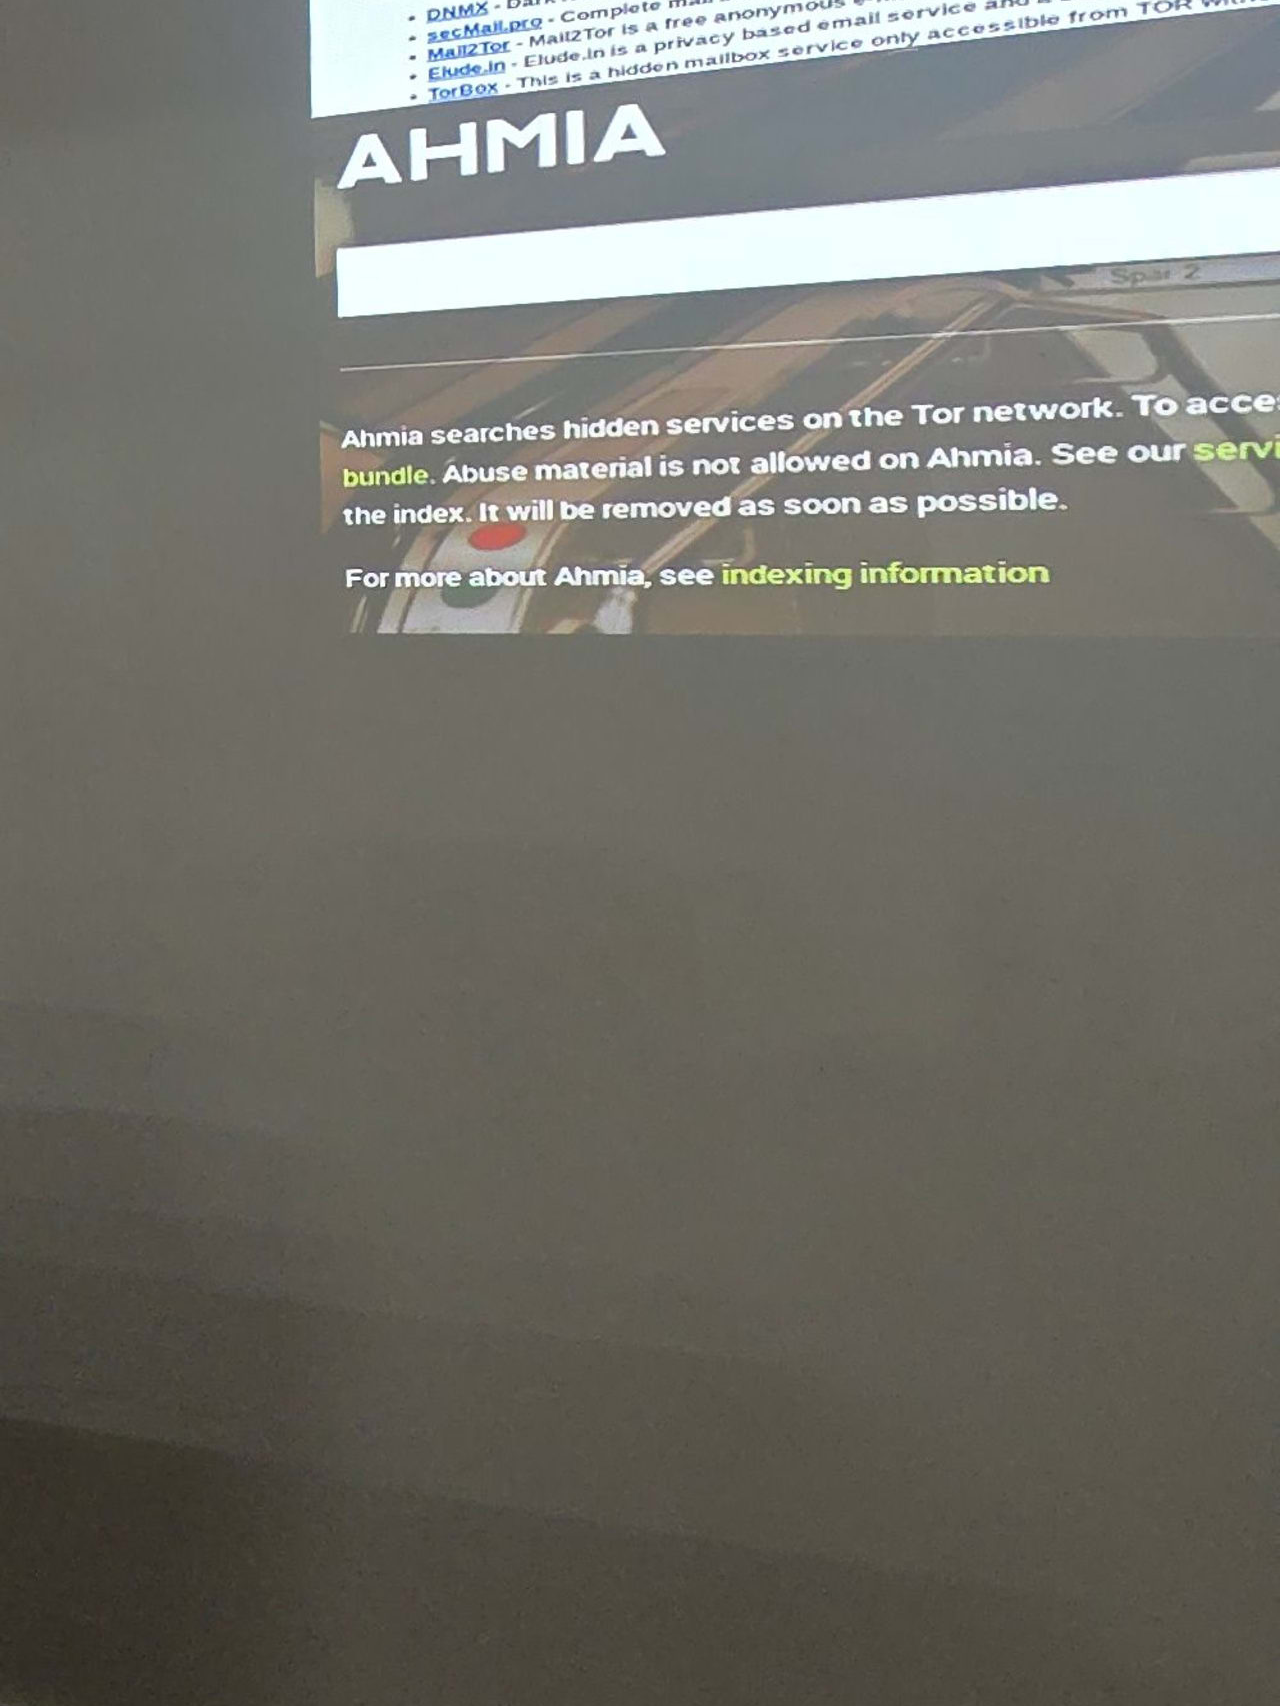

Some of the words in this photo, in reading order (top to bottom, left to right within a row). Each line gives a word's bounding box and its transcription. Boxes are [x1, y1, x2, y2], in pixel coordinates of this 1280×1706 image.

[427, 1, 488, 23] DNMX
[427, 16, 543, 41] secMail.pro
[560, 1, 661, 23] Complete
[610, 44, 628, 57] is
[635, 43, 647, 54] a
[653, 30, 735, 55] privacy
[742, 19, 811, 41] based
[817, 11, 881, 31] email
[887, 0, 977, 24] service
[427, 40, 510, 61] Mail2Tor
[529, 26, 615, 48] Mail2Tor
[622, 23, 639, 35] is
[645, 21, 658, 32] a
[665, 12, 708, 30] free
[429, 79, 498, 101] TorBox
[517, 74, 559, 88] This
[566, 71, 582, 83] is
[589, 70, 601, 80] a
[608, 60, 679, 78] hidden
[684, 48, 770, 70] mailbox
[778, 36, 863, 58] service
[871, 29, 920, 48] only
[927, 14, 1061, 40] accessible
[1069, 6, 1128, 24] from
[337, 103, 666, 189] AHMIA
[342, 426, 423, 449] Ahmia
[431, 420, 556, 445] searches
[564, 414, 659, 439] hidden
[666, 410, 794, 435] services
[803, 410, 842, 430] on
[849, 406, 902, 429] the
[912, 403, 965, 425] Tor
[973, 396, 1124, 424] network.
[1132, 394, 1177, 417] To
[1186, 393, 1280, 416] acce
[343, 464, 435, 488] bundle.
[442, 462, 528, 484] Abuse
[535, 456, 651, 481] material
[659, 454, 685, 478] is
[692, 456, 741, 476] not
[751, 450, 870, 476] allowed
[879, 452, 919, 471] on
[927, 442, 1042, 469] Ahmia.
[1052, 442, 1118, 465] See
[1128, 442, 1186, 462] our
[343, 505, 386, 525] the
[393, 503, 472, 524] index.
[479, 503, 500, 522] It
[507, 500, 554, 521] will
[560, 500, 594, 520] be
[603, 496, 732, 519] removed
[738, 499, 775, 516] as
[784, 495, 861, 515] soon
[868, 494, 908, 514] as
[917, 487, 1068, 518] possible.
[345, 568, 389, 588] For
[395, 570, 462, 588] more
[469, 566, 547, 587] about
[554, 563, 651, 589] Ahmia,
[660, 566, 714, 586] see
[722, 562, 852, 589] indexing
[860, 561, 1050, 585] information
